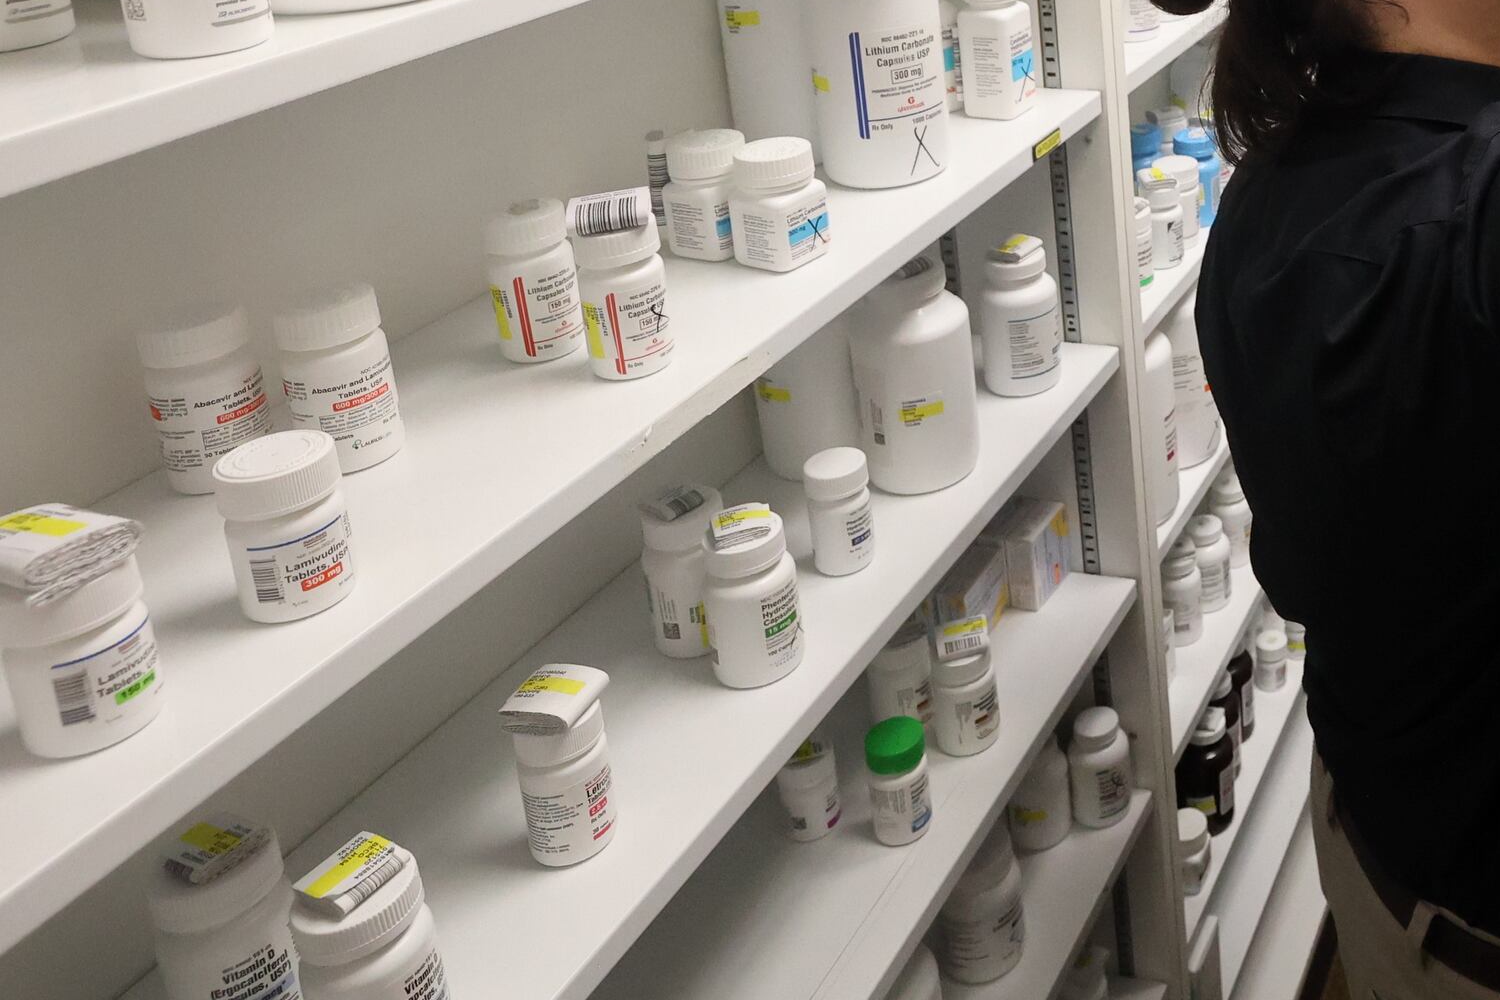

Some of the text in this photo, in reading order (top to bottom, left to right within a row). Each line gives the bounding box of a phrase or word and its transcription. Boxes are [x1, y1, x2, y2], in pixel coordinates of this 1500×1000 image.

[865, 35, 934, 56] Lithium Carbonate
[877, 48, 930, 67] Capsules USP
[895, 68, 922, 80] 300 mg
[805, 203, 826, 216] Carbonate
[528, 284, 553, 295] Lithium
[537, 289, 565, 301] Capsules
[551, 301, 562, 309] 150
[619, 302, 645, 312] Lithium
[312, 377, 363, 395] Abacavir and
[338, 377, 383, 400] Tablets, USP
[194, 390, 246, 409] Abacavir and
[335, 401, 350, 410] 600
[285, 546, 349, 584] Tablets, USP
[286, 540, 345, 573] Lamivudine
[306, 567, 341, 588] 300 mg
[223, 949, 275, 985] Vitamin D
[405, 959, 433, 995] Vitamin
